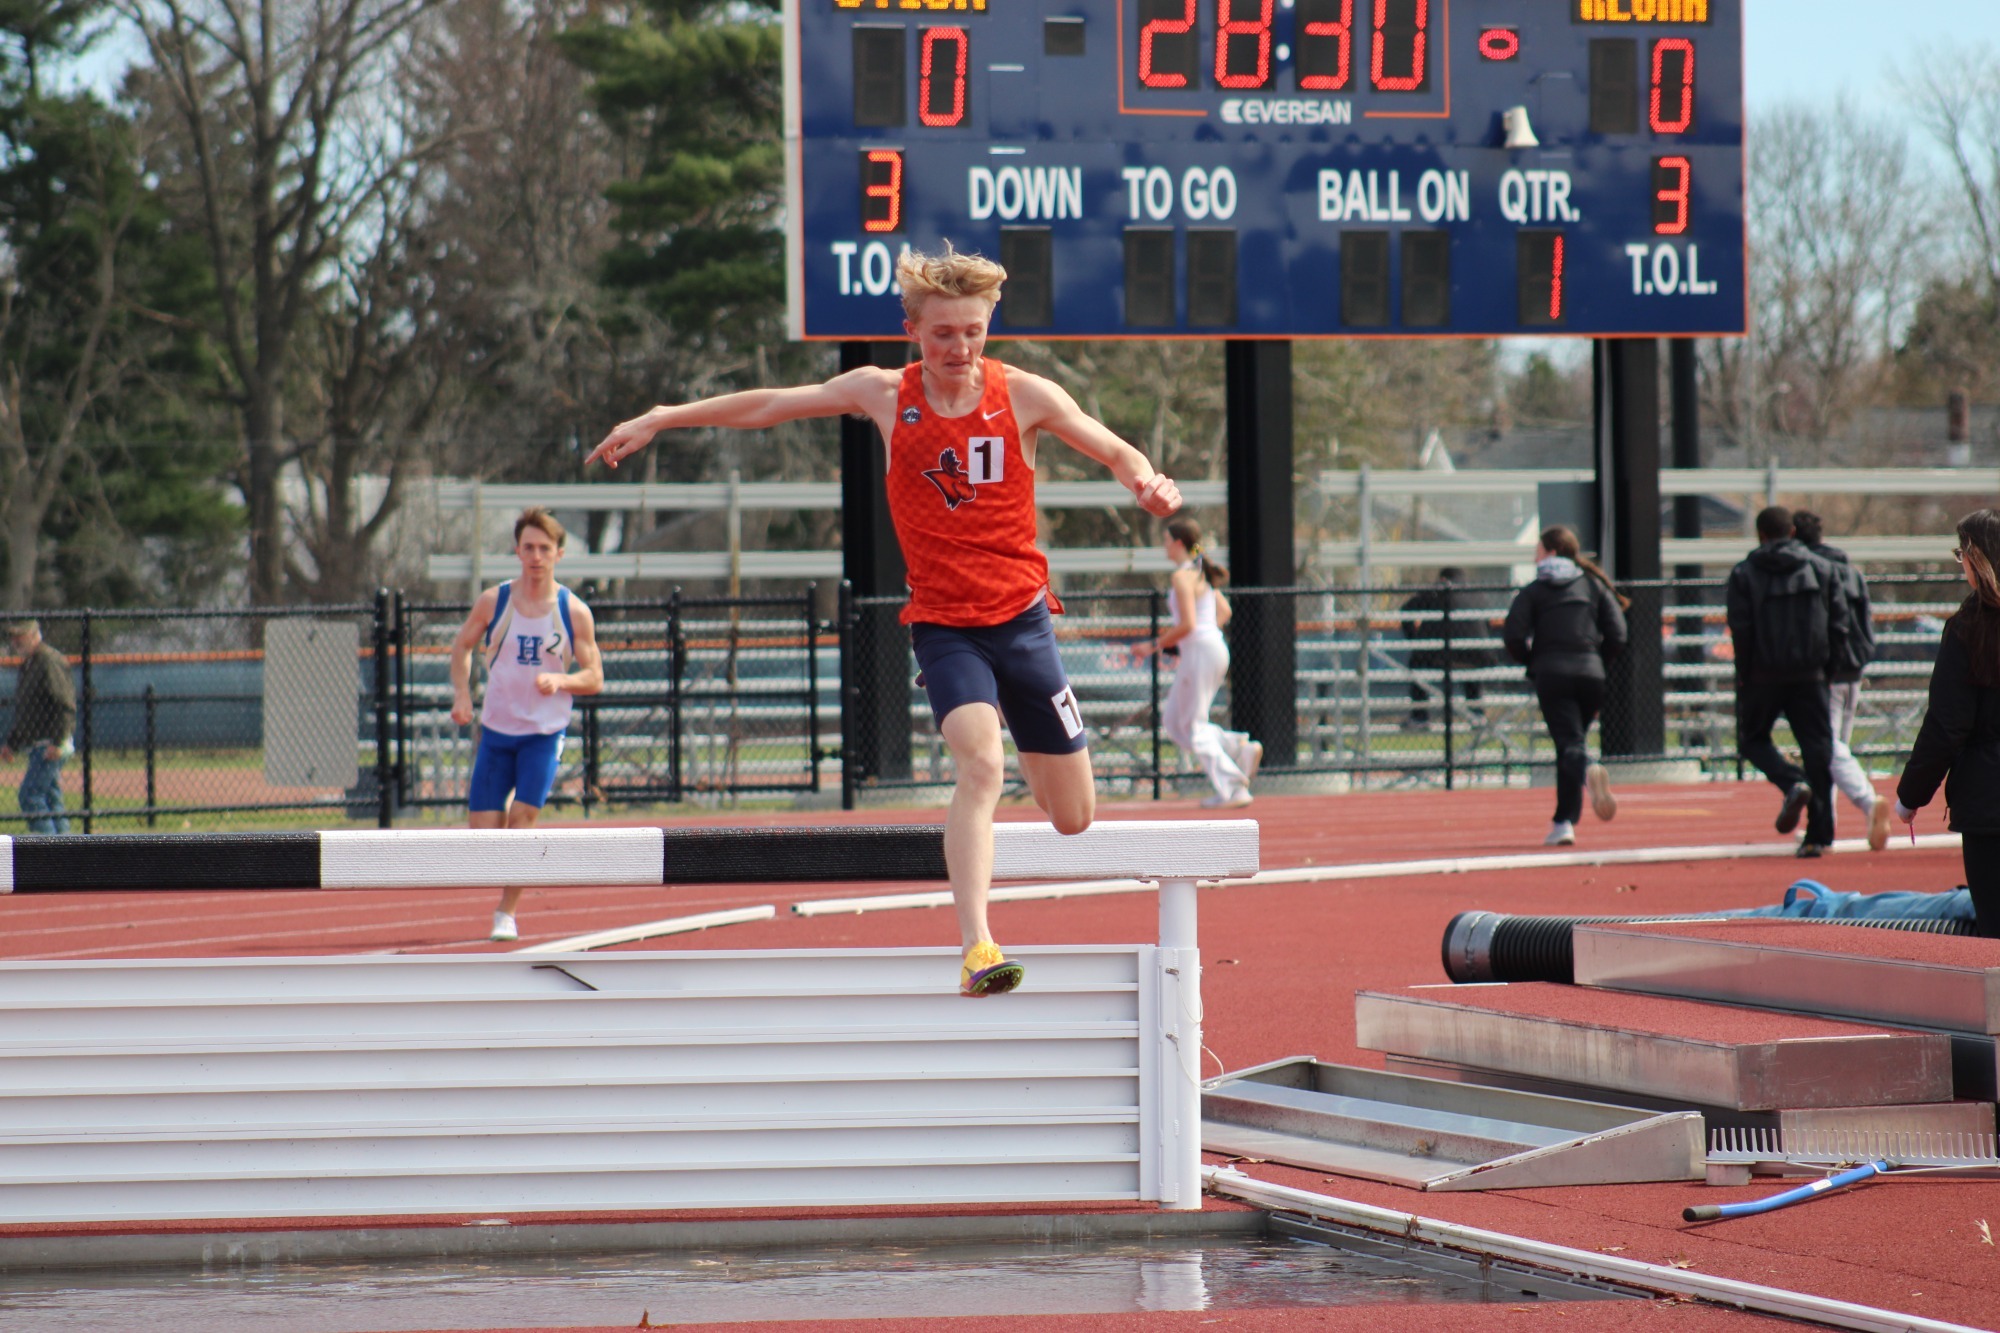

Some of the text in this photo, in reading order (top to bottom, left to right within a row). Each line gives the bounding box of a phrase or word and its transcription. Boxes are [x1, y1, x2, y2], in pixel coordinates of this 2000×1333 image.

[919, 27, 967, 126] 0
[1649, 38, 1694, 133] 0
[1243, 100, 1351, 124] EVERSAN
[865, 150, 902, 232] 3
[968, 166, 1083, 220] DOWN
[1122, 166, 1237, 220] TO GO
[1318, 169, 1470, 222] BALL ON
[1499, 170, 1580, 223] QTR.
[1654, 157, 1691, 234] 3
[831, 240, 911, 296] T.O.
[1549, 235, 1564, 319] 1
[1625, 243, 1717, 295] T.O.L.
[974, 440, 992, 480] 1
[516, 635, 543, 666] H
[546, 632, 562, 655] 2
[1060, 691, 1081, 729] 1
